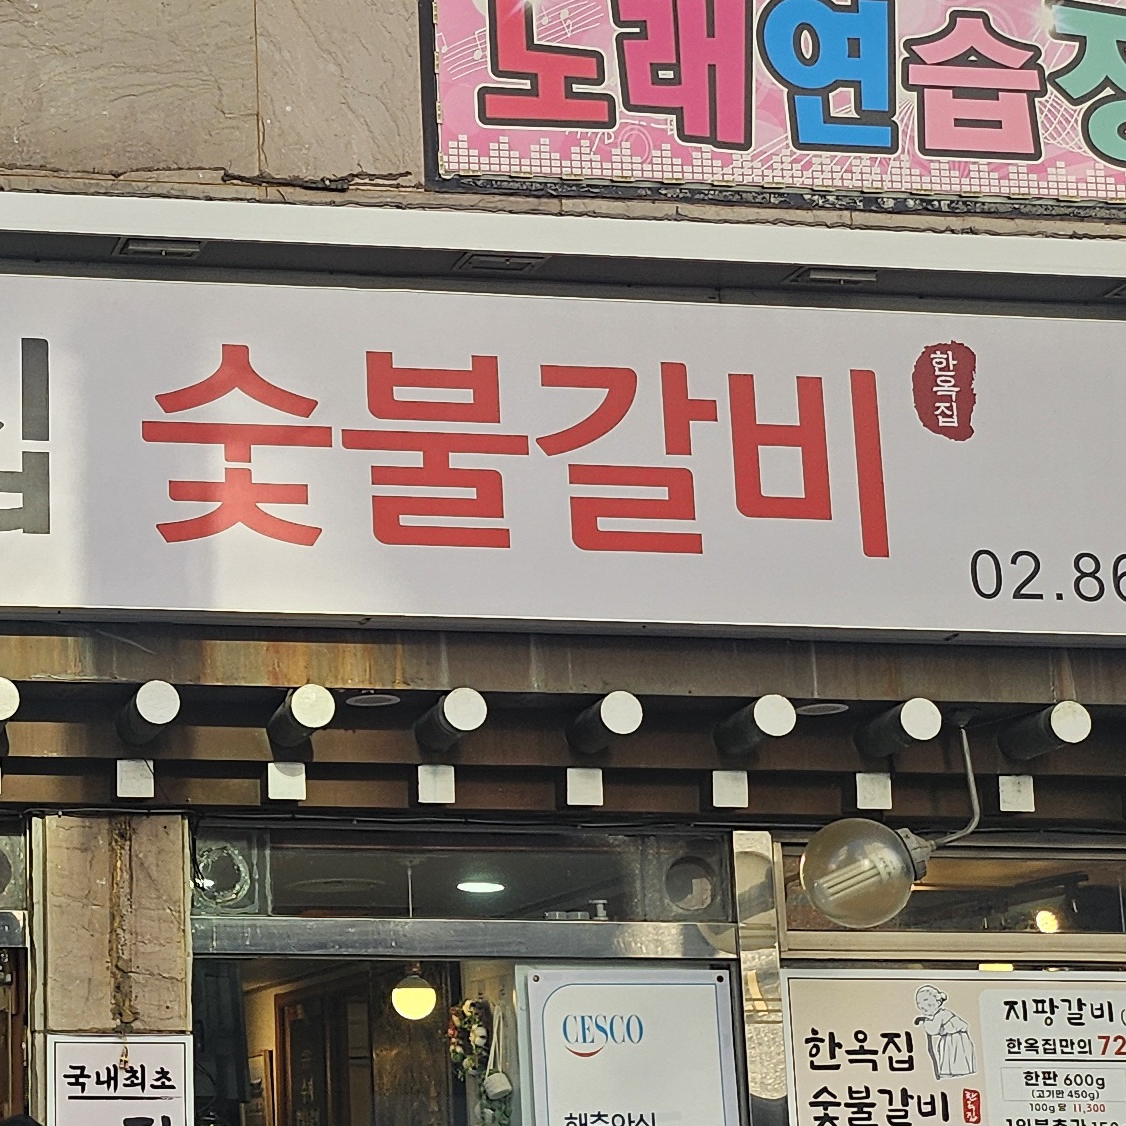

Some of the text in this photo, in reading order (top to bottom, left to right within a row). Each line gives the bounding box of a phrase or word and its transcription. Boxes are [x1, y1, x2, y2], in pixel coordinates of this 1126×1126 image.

[930, 351, 961, 427] 한옥집
[142, 344, 890, 557] 숯불갈비
[1003, 997, 1114, 1026] 지팡갈비
[563, 1014, 644, 1045] CESCO
[805, 1028, 915, 1071] 한옥집
[1005, 1038, 1093, 1055] 한옥집만의
[63, 1064, 176, 1093] 국내최초
[1023, 1070, 1106, 1090] 한판 600g
[1029, 1103, 1056, 1113] 100g
